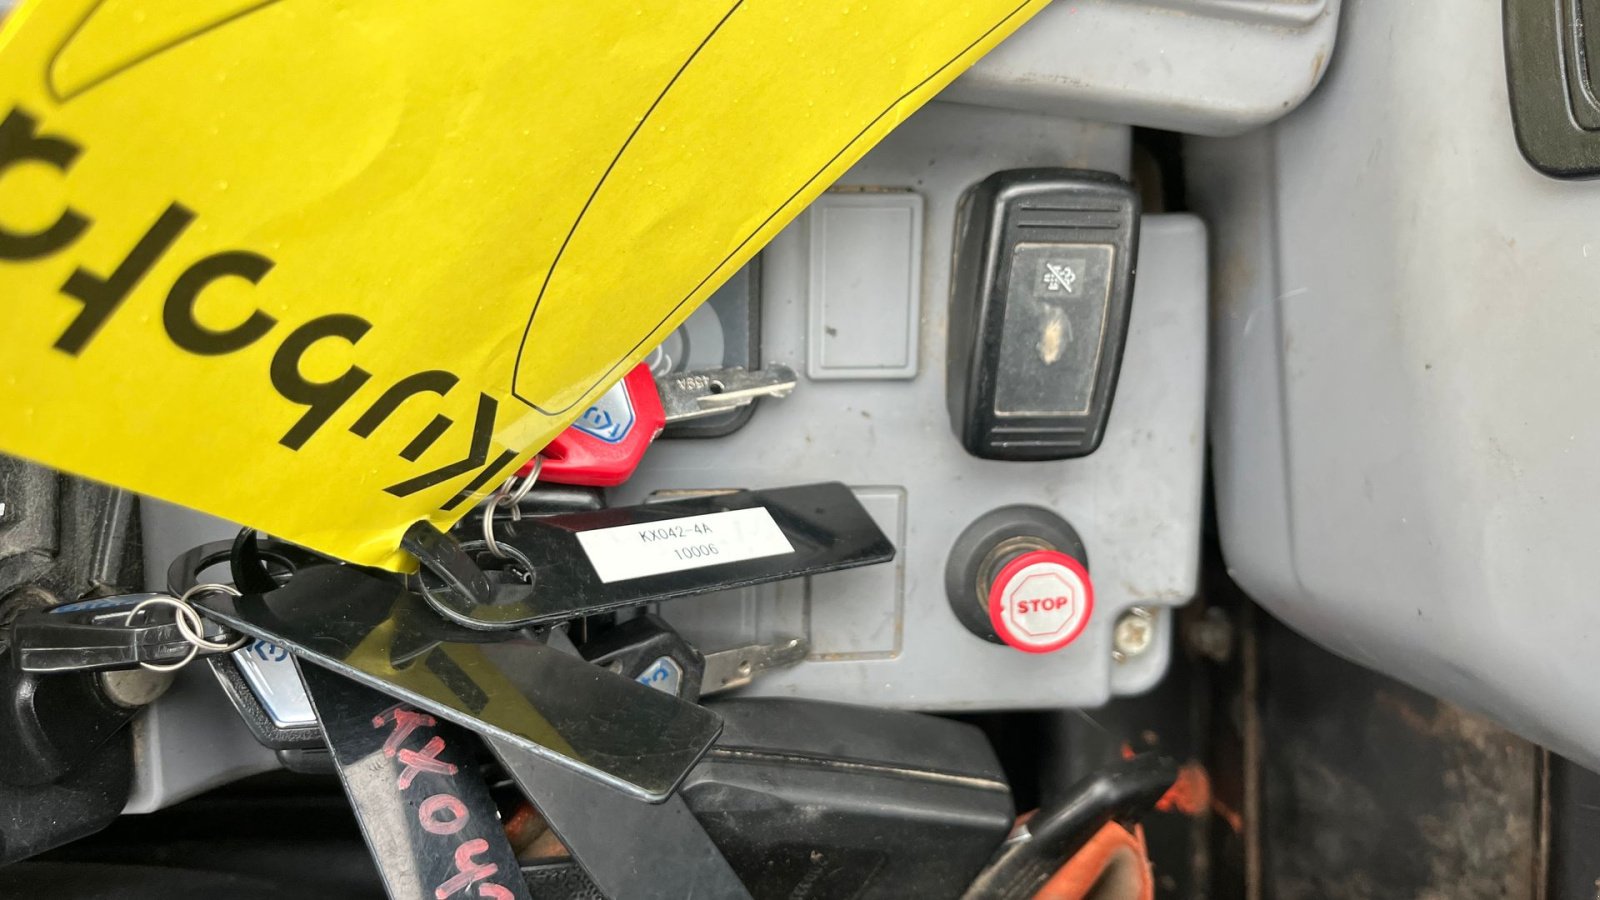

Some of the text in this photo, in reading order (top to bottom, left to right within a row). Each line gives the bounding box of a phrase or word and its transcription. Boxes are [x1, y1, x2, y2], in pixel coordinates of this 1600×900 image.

[0, 105, 520, 511] Kubota
[638, 522, 713, 542] KX042-4A
[674, 543, 719, 560] 10006
[1017, 596, 1068, 614] STOP
